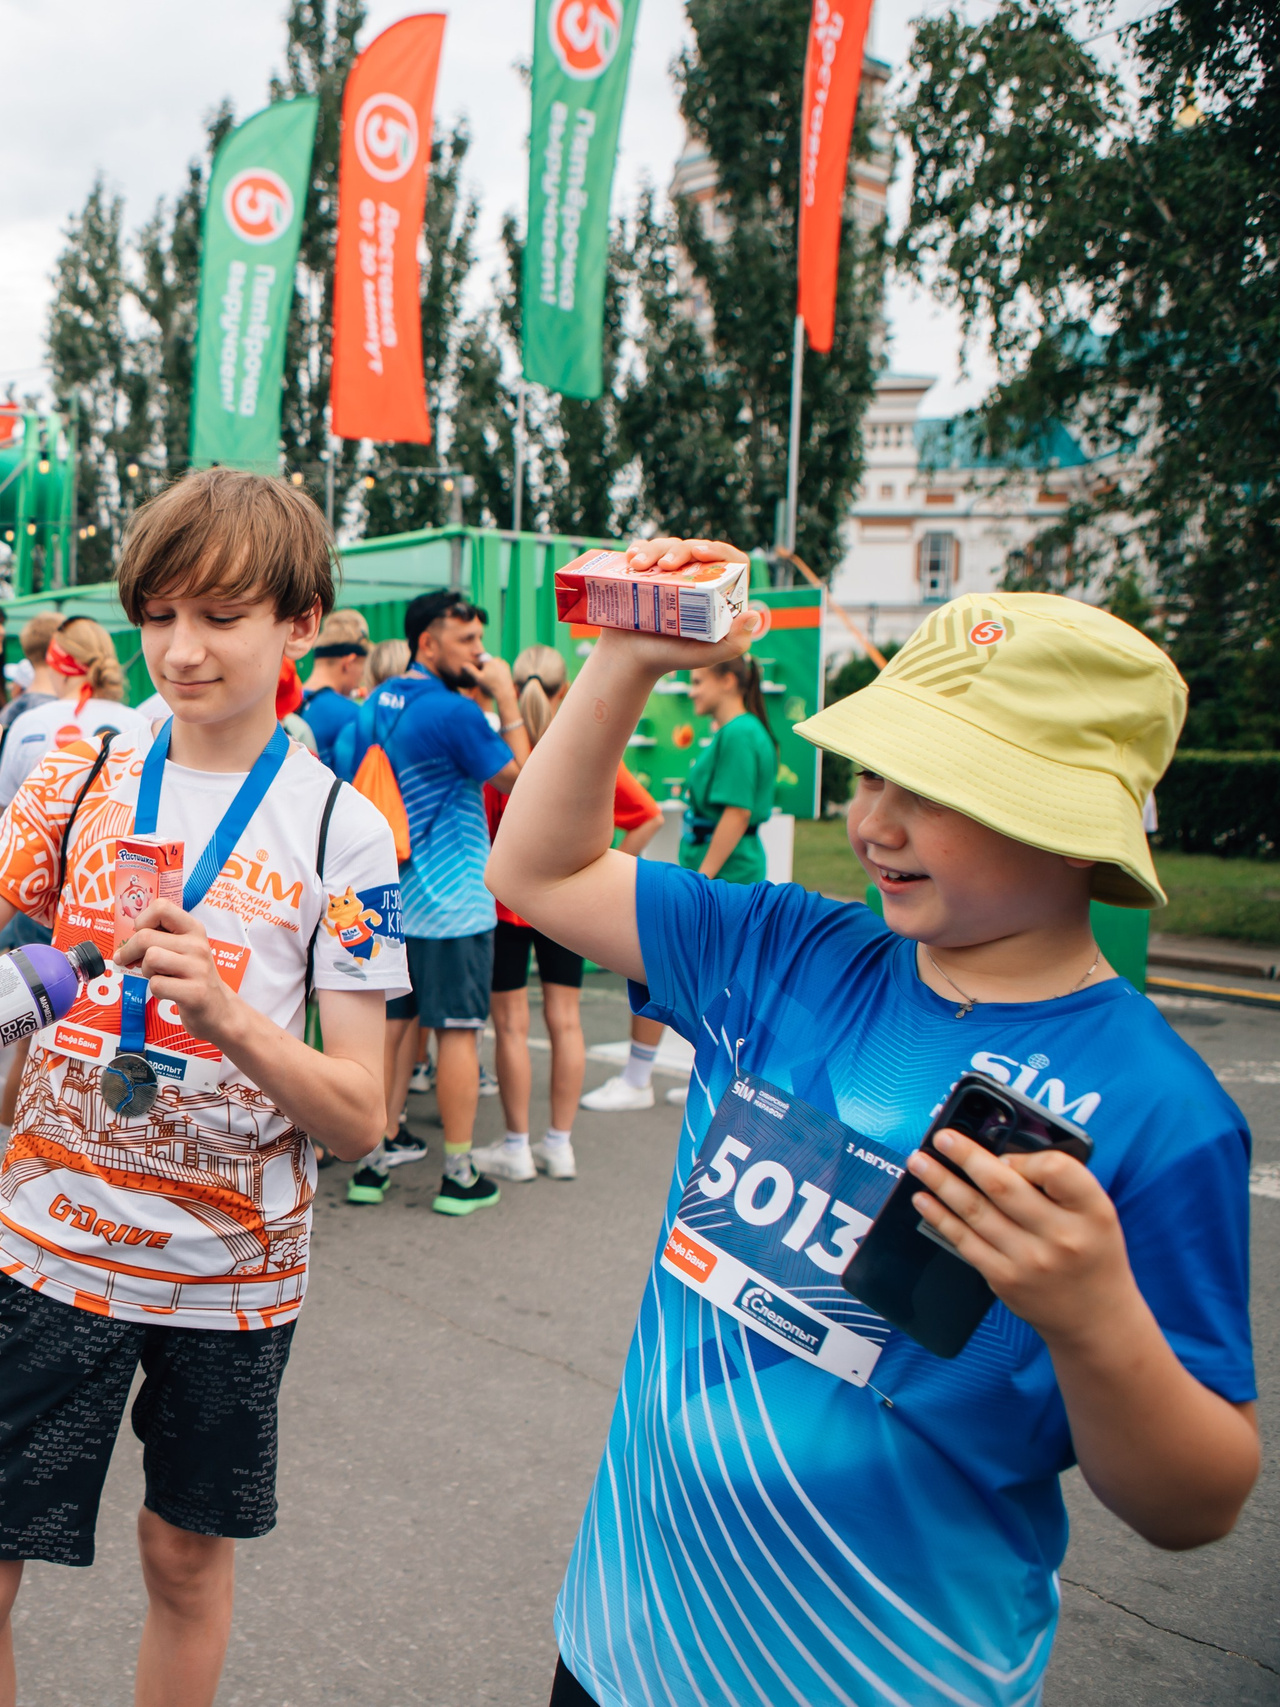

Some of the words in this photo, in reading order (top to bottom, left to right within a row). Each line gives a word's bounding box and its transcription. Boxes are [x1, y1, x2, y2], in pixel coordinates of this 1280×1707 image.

[559, 108, 595, 310] Пятёрочка
[378, 202, 400, 347] Доставка
[239, 264, 276, 417] Пятёрочка
[94, 925, 114, 934] МАРАФО
[218, 950, 240, 962] 2024
[57, 1031, 78, 1045] Альфа
[78, 1037, 98, 1050] Банк
[846, 1142, 855, 1154] 3
[855, 1148, 905, 1179] АВГУСТ
[698, 1134, 875, 1275] 5013
[685, 1250, 709, 1272] Банк
[11, 1304, 27, 1312] FILA
[0, 1323, 13, 1333] FILA
[750, 1297, 819, 1346] Следопыт
[74, 1326, 90, 1334] FILA
[56, 1419, 72, 1427] FILA
[48, 1428, 64, 1436] FILA
[257, 1430, 271, 1439] FILA
